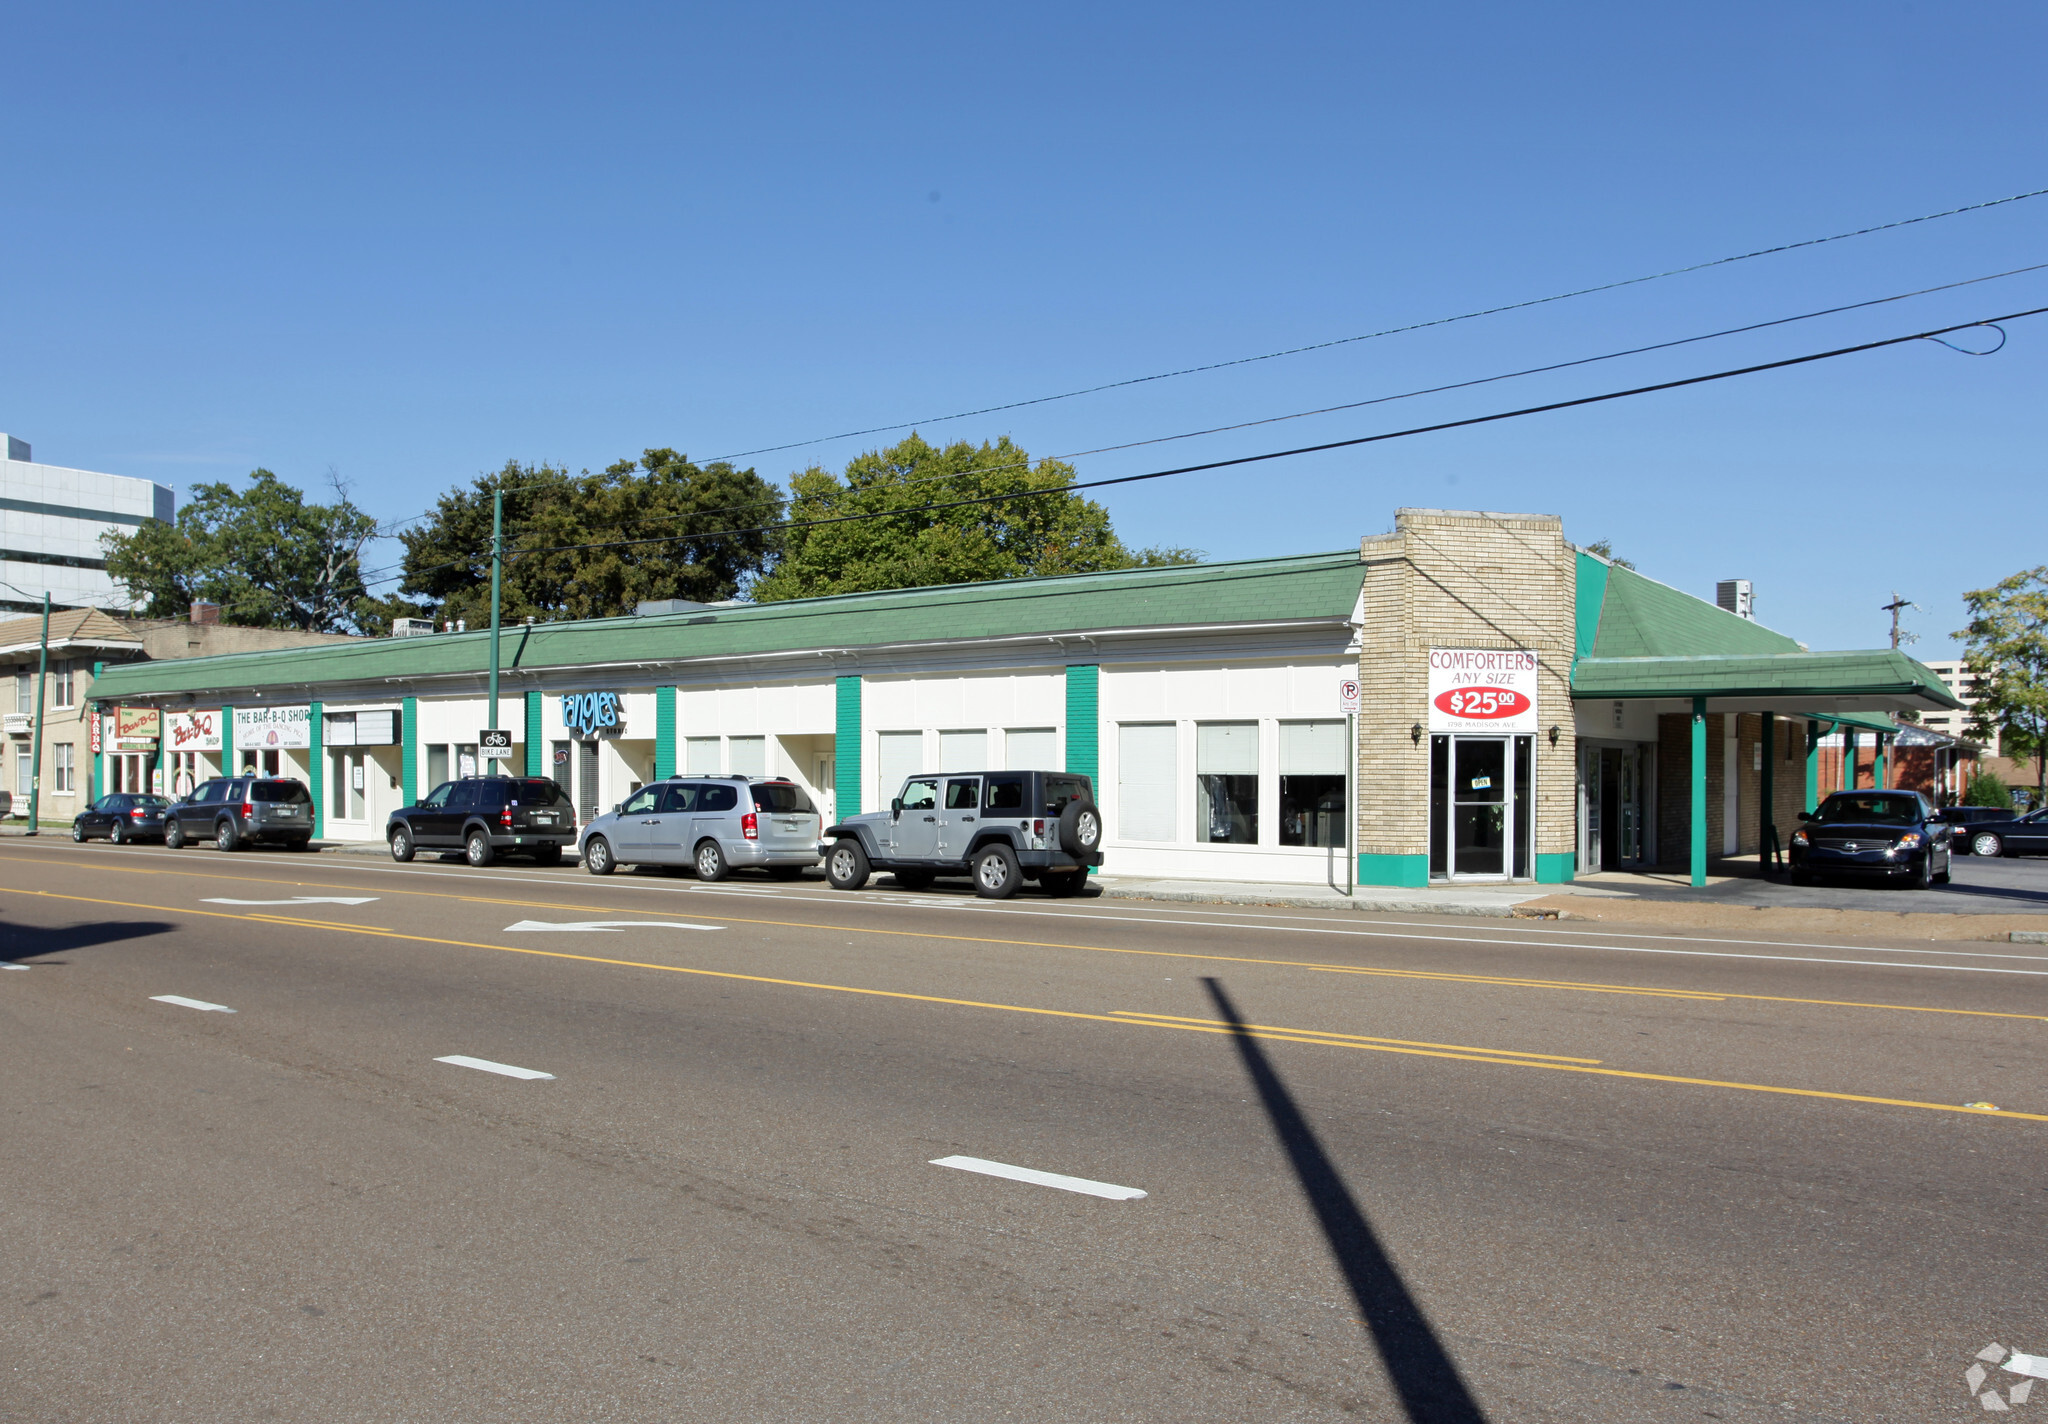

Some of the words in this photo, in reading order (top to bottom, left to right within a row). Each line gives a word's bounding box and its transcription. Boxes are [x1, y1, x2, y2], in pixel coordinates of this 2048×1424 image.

[1430, 652, 1534, 670] COMFORTERS
[1452, 672, 1481, 684] ANY
[1485, 673, 1516, 684] SIZE
[237, 712, 251, 724] THE
[253, 710, 286, 723] BAR-B-Q
[288, 709, 310, 722] SHOP
[481, 748, 495, 756] BIKE
[496, 748, 510, 756] LANE
